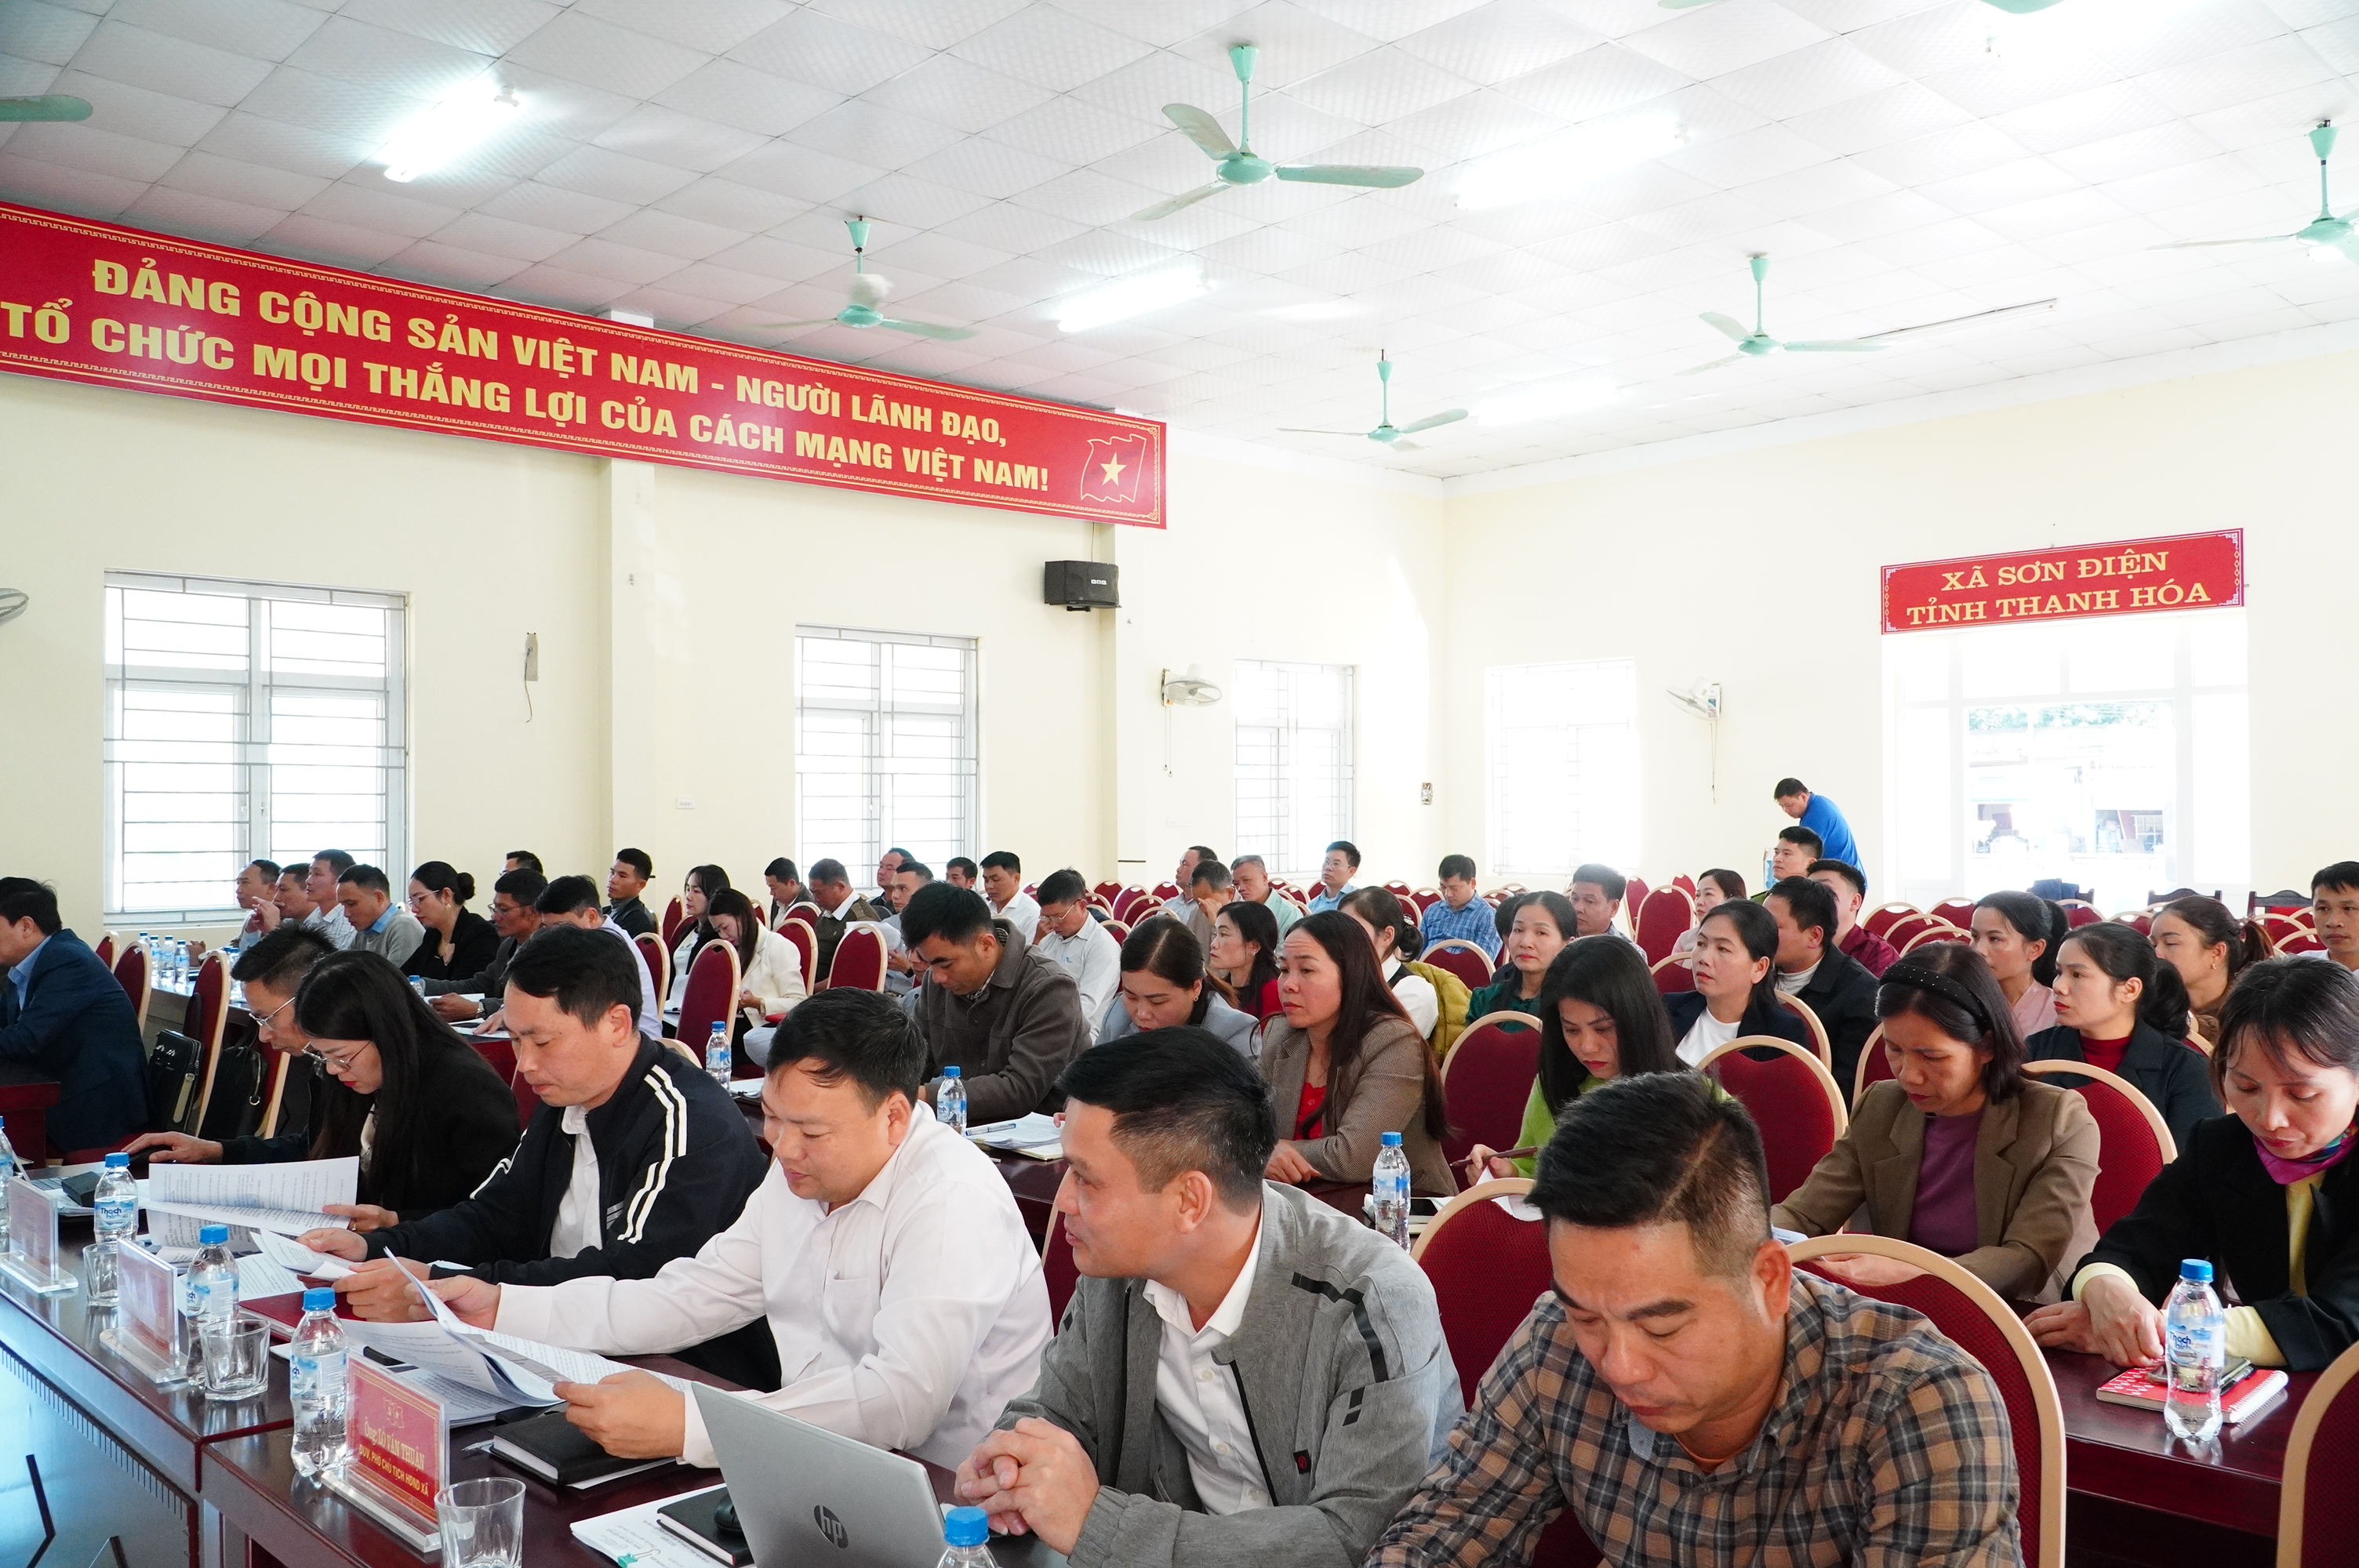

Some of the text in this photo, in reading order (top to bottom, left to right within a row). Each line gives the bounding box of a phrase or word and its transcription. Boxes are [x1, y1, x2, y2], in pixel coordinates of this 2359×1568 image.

[92, 257, 241, 317] ĐẢNG
[260, 291, 391, 343] CỘNG
[408, 314, 498, 361] SẢN
[512, 336, 598, 379] VIỆT
[611, 353, 698, 394] NAM
[736, 374, 841, 418] NGƯỜI
[852, 393, 932, 433] LÃNH
[941, 410, 1007, 448] ĐẠO,
[1, 297, 1049, 492] TỔ CHỨC MỌI THẮNG LỢI CỦA CÁCH MẠNG VIỆT NAM!
[1941, 548, 2169, 592] XÃ SƠN ĐIỆN
[1906, 578, 2212, 626] TỈNH THANH HÓA
[818, 1504, 843, 1548] hp
